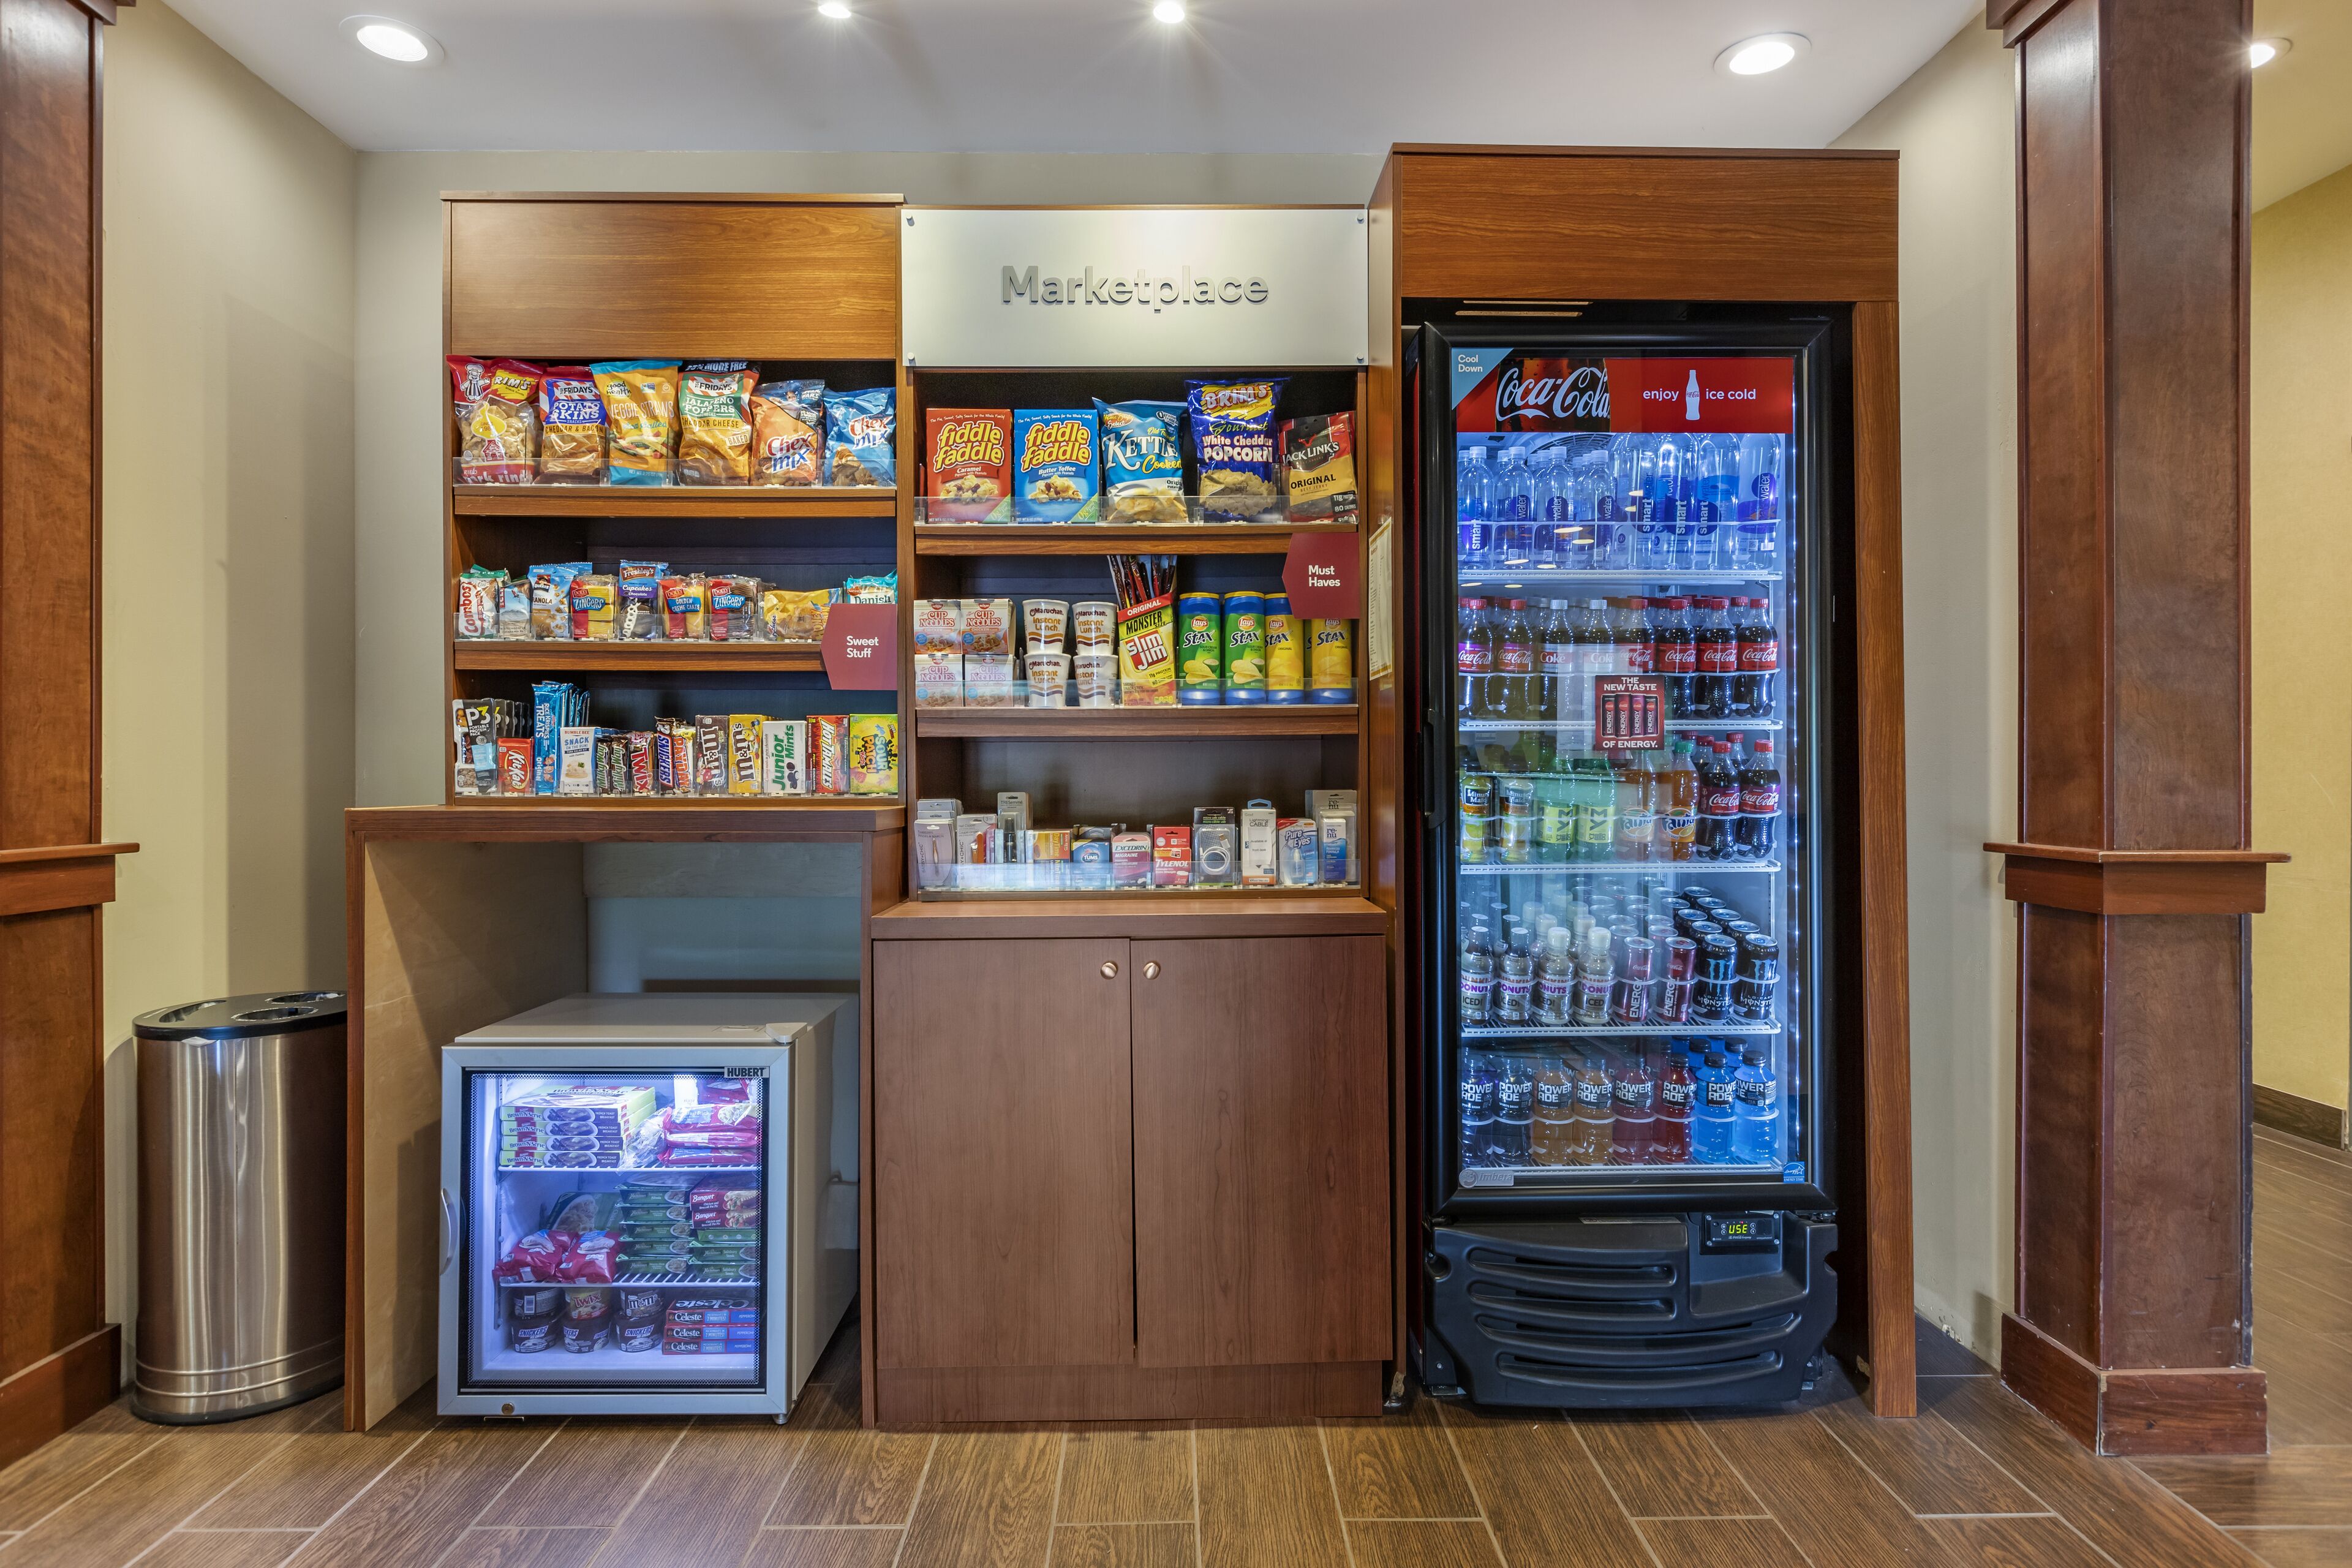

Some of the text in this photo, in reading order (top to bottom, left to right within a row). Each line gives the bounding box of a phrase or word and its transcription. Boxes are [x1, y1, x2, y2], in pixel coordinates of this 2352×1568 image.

[1003, 265, 1268, 314] Marketplace
[1458, 355, 1479, 363] Cool
[1458, 364, 1483, 373] Down
[606, 380, 627, 390] good
[606, 387, 631, 396] health
[699, 382, 733, 391] FRIDAYS
[1204, 385, 1269, 410] BRIM'S
[1495, 366, 1610, 421] Coca-Cola
[1643, 388, 1756, 402] enjoy ice cold
[554, 402, 600, 411] POTATO
[608, 400, 674, 419] VEGGIE STRAWS
[684, 404, 735, 414] POPPERS
[551, 409, 600, 420] SKINS
[713, 420, 739, 428] CHEESE
[849, 415, 893, 437] Chex
[1209, 421, 1268, 435] Gourmet
[728, 434, 748, 445] BAKED
[939, 421, 1002, 448] fiddle
[1026, 421, 1089, 448] fiddle
[1202, 434, 1273, 447] White Cheddar
[767, 432, 816, 457] Chex
[1102, 429, 1178, 470] KETTLE
[1307, 442, 1340, 458] LINK'S
[935, 442, 1003, 470] faddle
[1022, 442, 1090, 470] faddle
[1204, 446, 1273, 462] POPCORN
[772, 449, 810, 473] mix
[1142, 454, 1182, 474] Cooked
[1291, 473, 1336, 489] ORIGINAL
[1760, 474, 1770, 500] water
[1518, 496, 1526, 519] water
[1603, 496, 1612, 519] water
[1472, 519, 1481, 549] smart
[623, 568, 654, 578] Freshley's
[1308, 565, 1335, 575] Must
[1308, 576, 1341, 587] Haves
[854, 595, 891, 603] Danish
[460, 586, 479, 633] Combos
[1127, 599, 1161, 616] ORIGINAL
[919, 618, 955, 627] NOODLES
[967, 617, 1001, 627] NOODLES
[1126, 611, 1163, 635] MONSTER
[846, 635, 879, 646] Sweet
[1126, 633, 1163, 656] slim
[846, 648, 872, 658] Stuff
[1137, 646, 1168, 671] jim
[1458, 649, 1492, 665] Coca-Cola
[1498, 648, 1532, 664] Coca-Cola
[1540, 651, 1566, 663] Coke
[1591, 652, 1615, 663] Coke
[1703, 649, 1738, 662] Coca-Cola
[1743, 648, 1777, 662] Coca-Cola
[921, 673, 956, 682] NOODLES
[971, 673, 1006, 682] NOODLES
[466, 706, 491, 726] P3
[535, 706, 545, 738] TREATS
[564, 736, 589, 745] SNACK
[785, 725, 794, 760] Mints
[658, 734, 671, 785] SNICKERS
[863, 736, 877, 774] PATCH
[875, 736, 888, 771] SOUR
[673, 736, 691, 788] PAYDAY
[772, 734, 786, 791] Junior
[1740, 790, 1776, 806] Coca-Cola
[1285, 829, 1303, 841] Pure
[1293, 836, 1311, 848] Eyes
[1630, 977, 1642, 1018] ENERGY
[1663, 978, 1676, 1017] ENERGY
[727, 1068, 765, 1077] HUBERT
[1461, 1082, 1493, 1094] POWER
[1499, 1082, 1531, 1093] POWER
[1538, 1082, 1572, 1094] POWER
[1578, 1082, 1612, 1093] POWER
[1616, 1080, 1651, 1093] POWER
[1664, 1082, 1697, 1093] POWER
[1577, 1091, 1597, 1102] ADE
[1616, 1089, 1637, 1101] ADE
[1478, 1172, 1513, 1182] imbera
[1728, 1224, 1747, 1234] USE
[676, 1299, 749, 1309] Celeste
[519, 1326, 548, 1336] SNICKERS
[626, 1326, 653, 1335] SNICKERS
